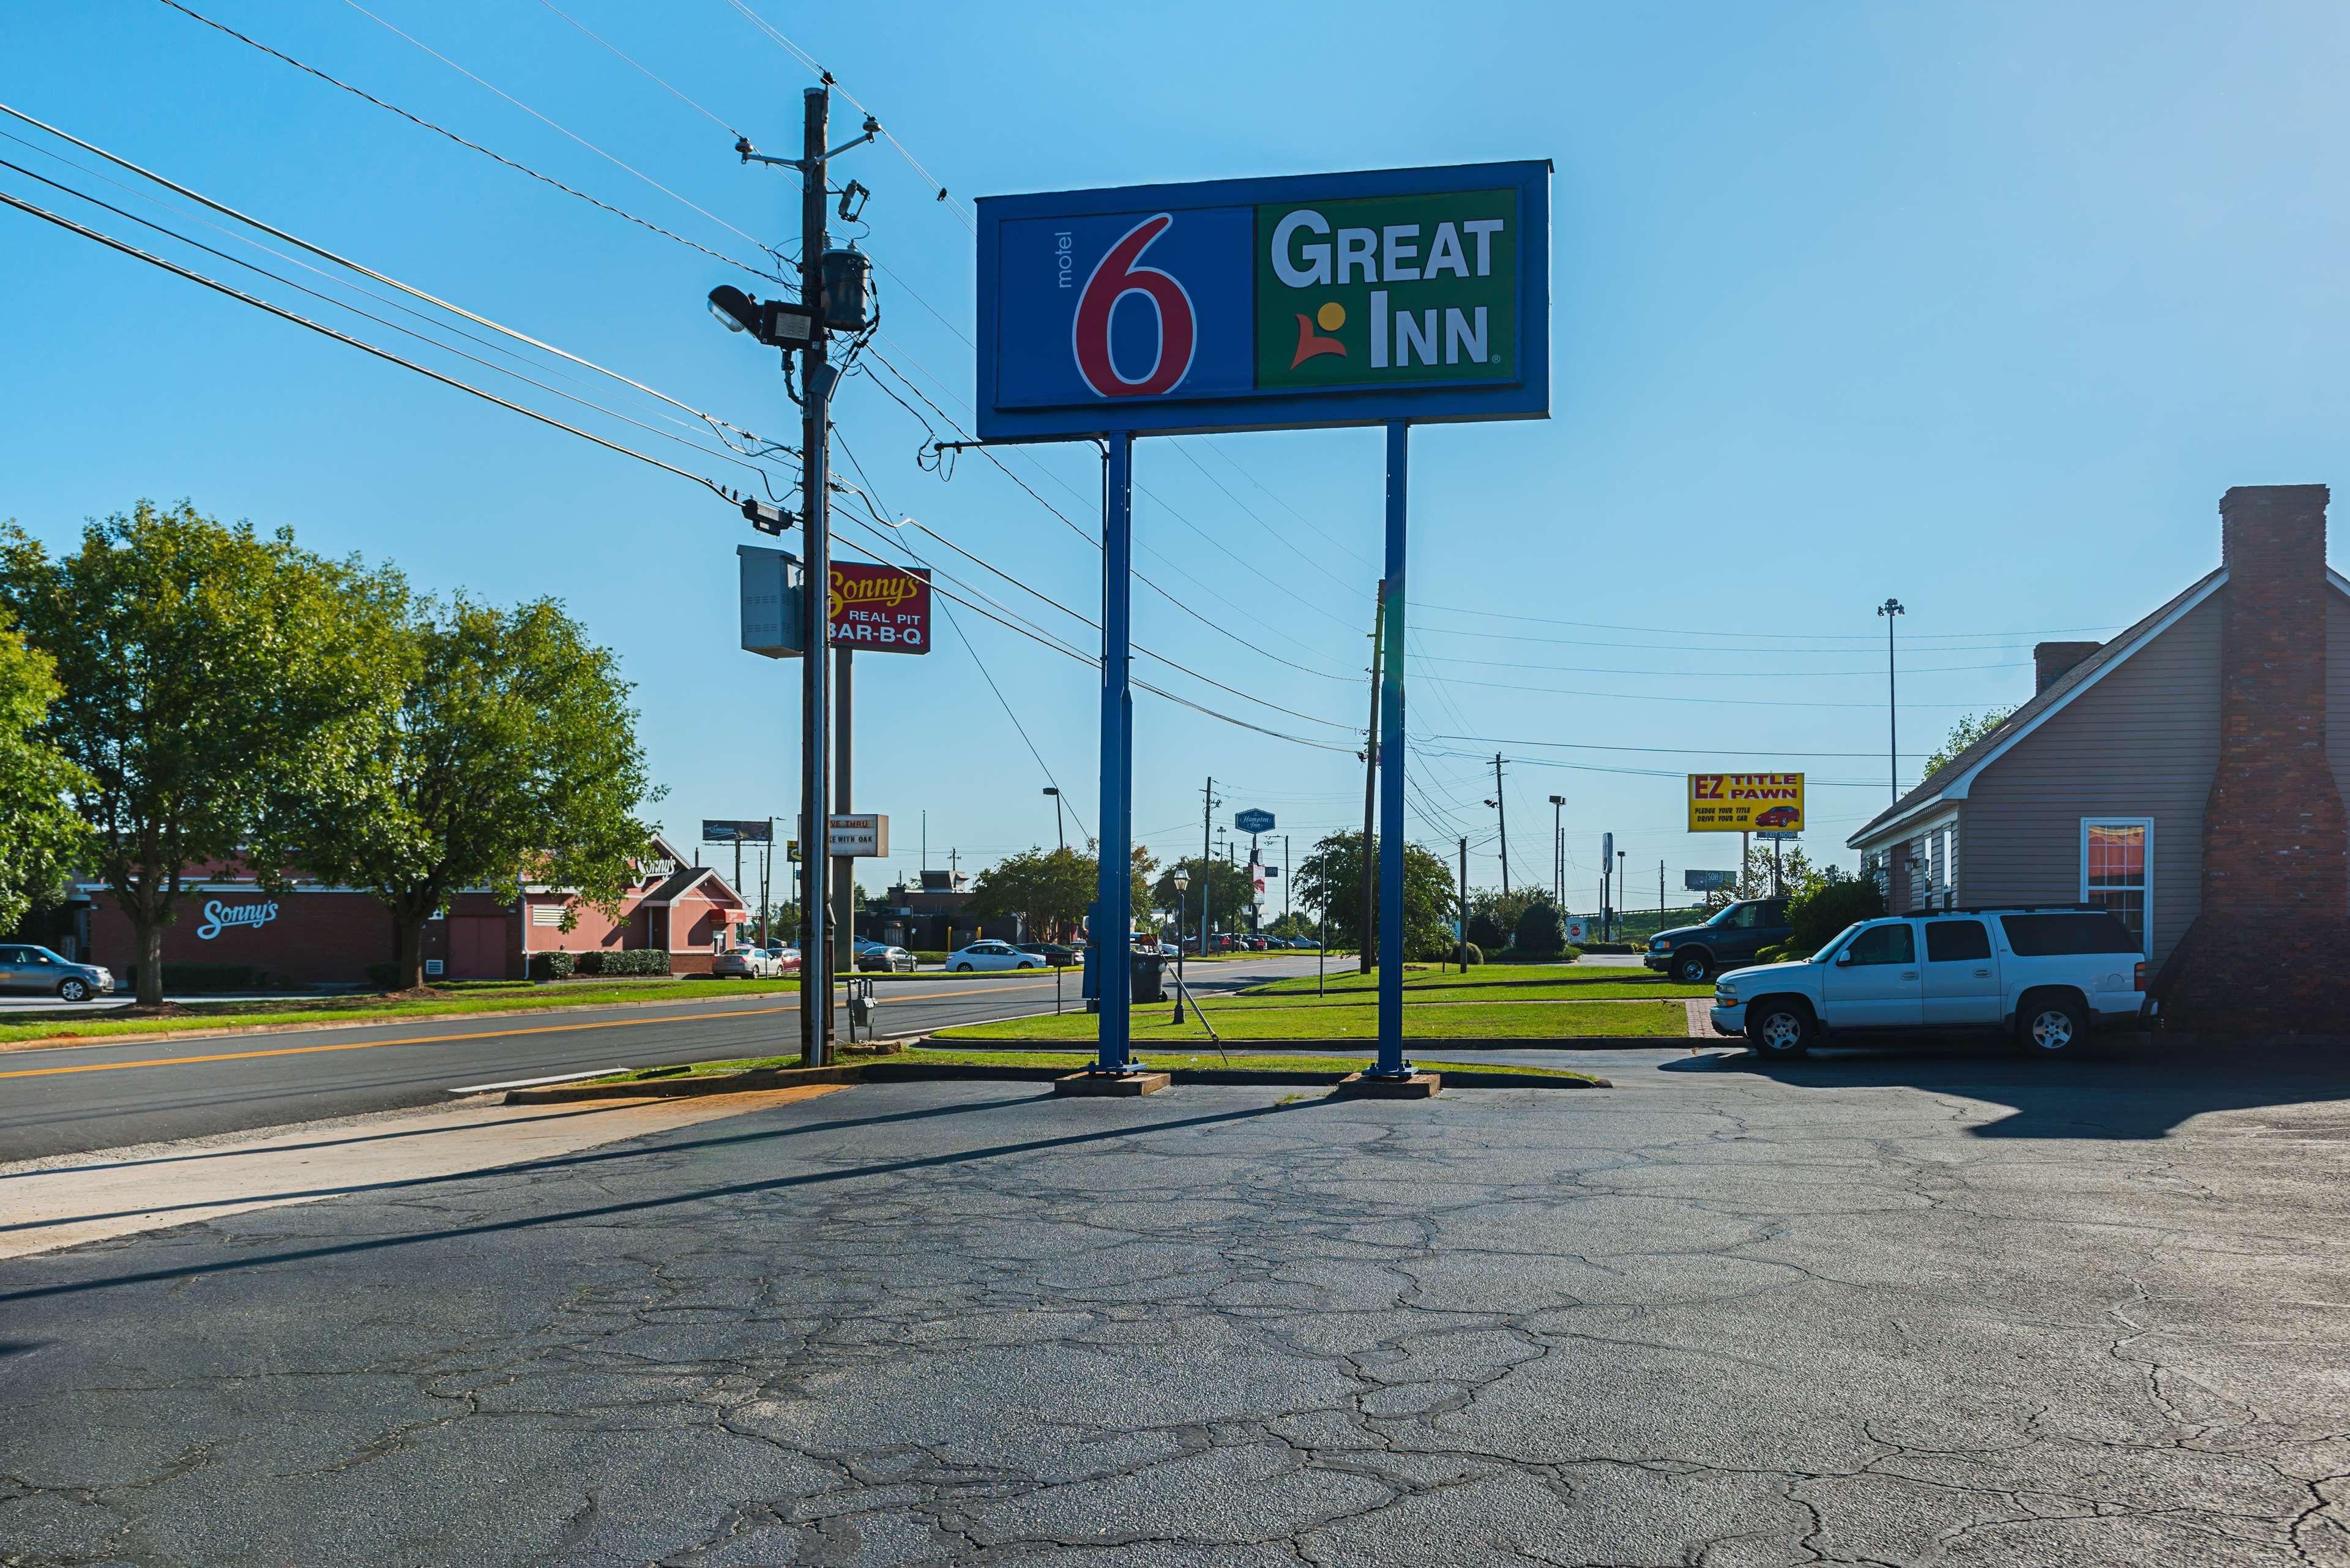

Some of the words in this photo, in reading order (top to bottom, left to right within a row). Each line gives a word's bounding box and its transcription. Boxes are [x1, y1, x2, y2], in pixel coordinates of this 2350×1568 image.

[1271, 209, 1504, 288] GREAT
[1054, 231, 1072, 288] motel
[1072, 213, 1198, 397] 6
[849, 610, 890, 623] REAL
[897, 614, 921, 625] PIT
[1693, 775, 1724, 800] EZ
[1730, 774, 1797, 786] TITLE
[1729, 789, 1797, 800] PAWN
[197, 900, 278, 939] Sonny's
